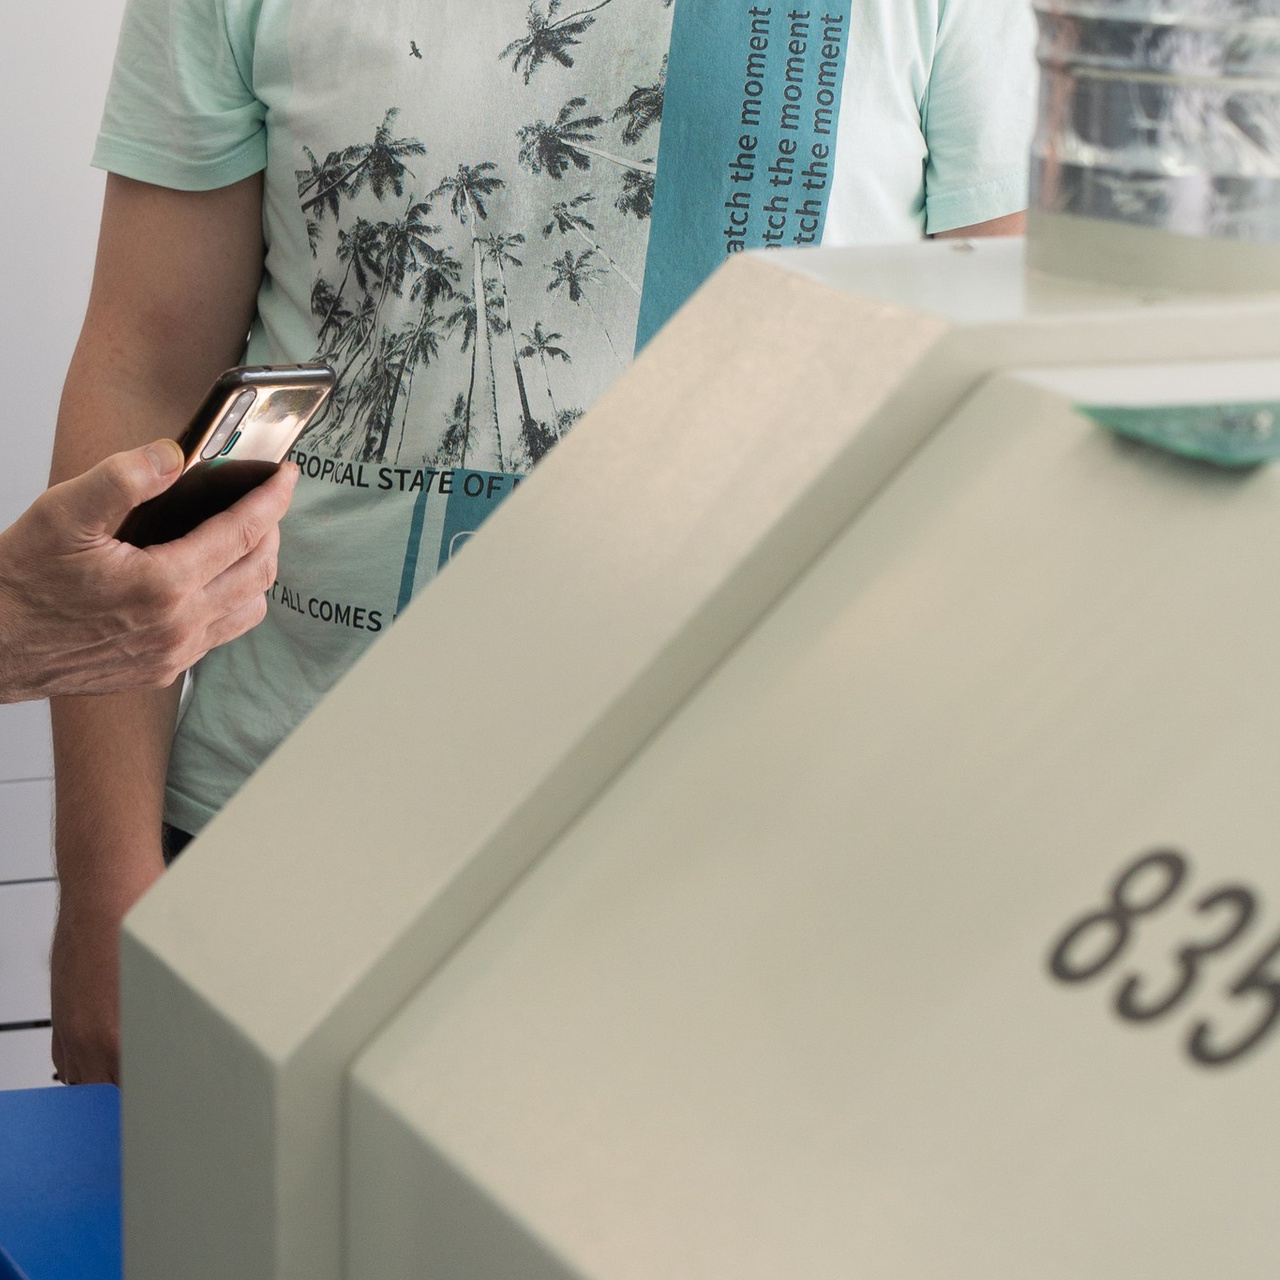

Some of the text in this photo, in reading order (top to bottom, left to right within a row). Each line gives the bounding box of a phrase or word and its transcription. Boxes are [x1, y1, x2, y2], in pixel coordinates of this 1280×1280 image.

[780, 9, 811, 130] moment
[793, 12, 843, 248] tch the moment
[723, 5, 772, 260] atch the moment
[768, 138, 797, 188] the
[377, 466, 454, 495] STATE
[463, 472, 504, 500] OF
[280, 585, 305, 615] ALL
[308, 597, 383, 633] COMES
[1046, 847, 1280, 1070] 835
